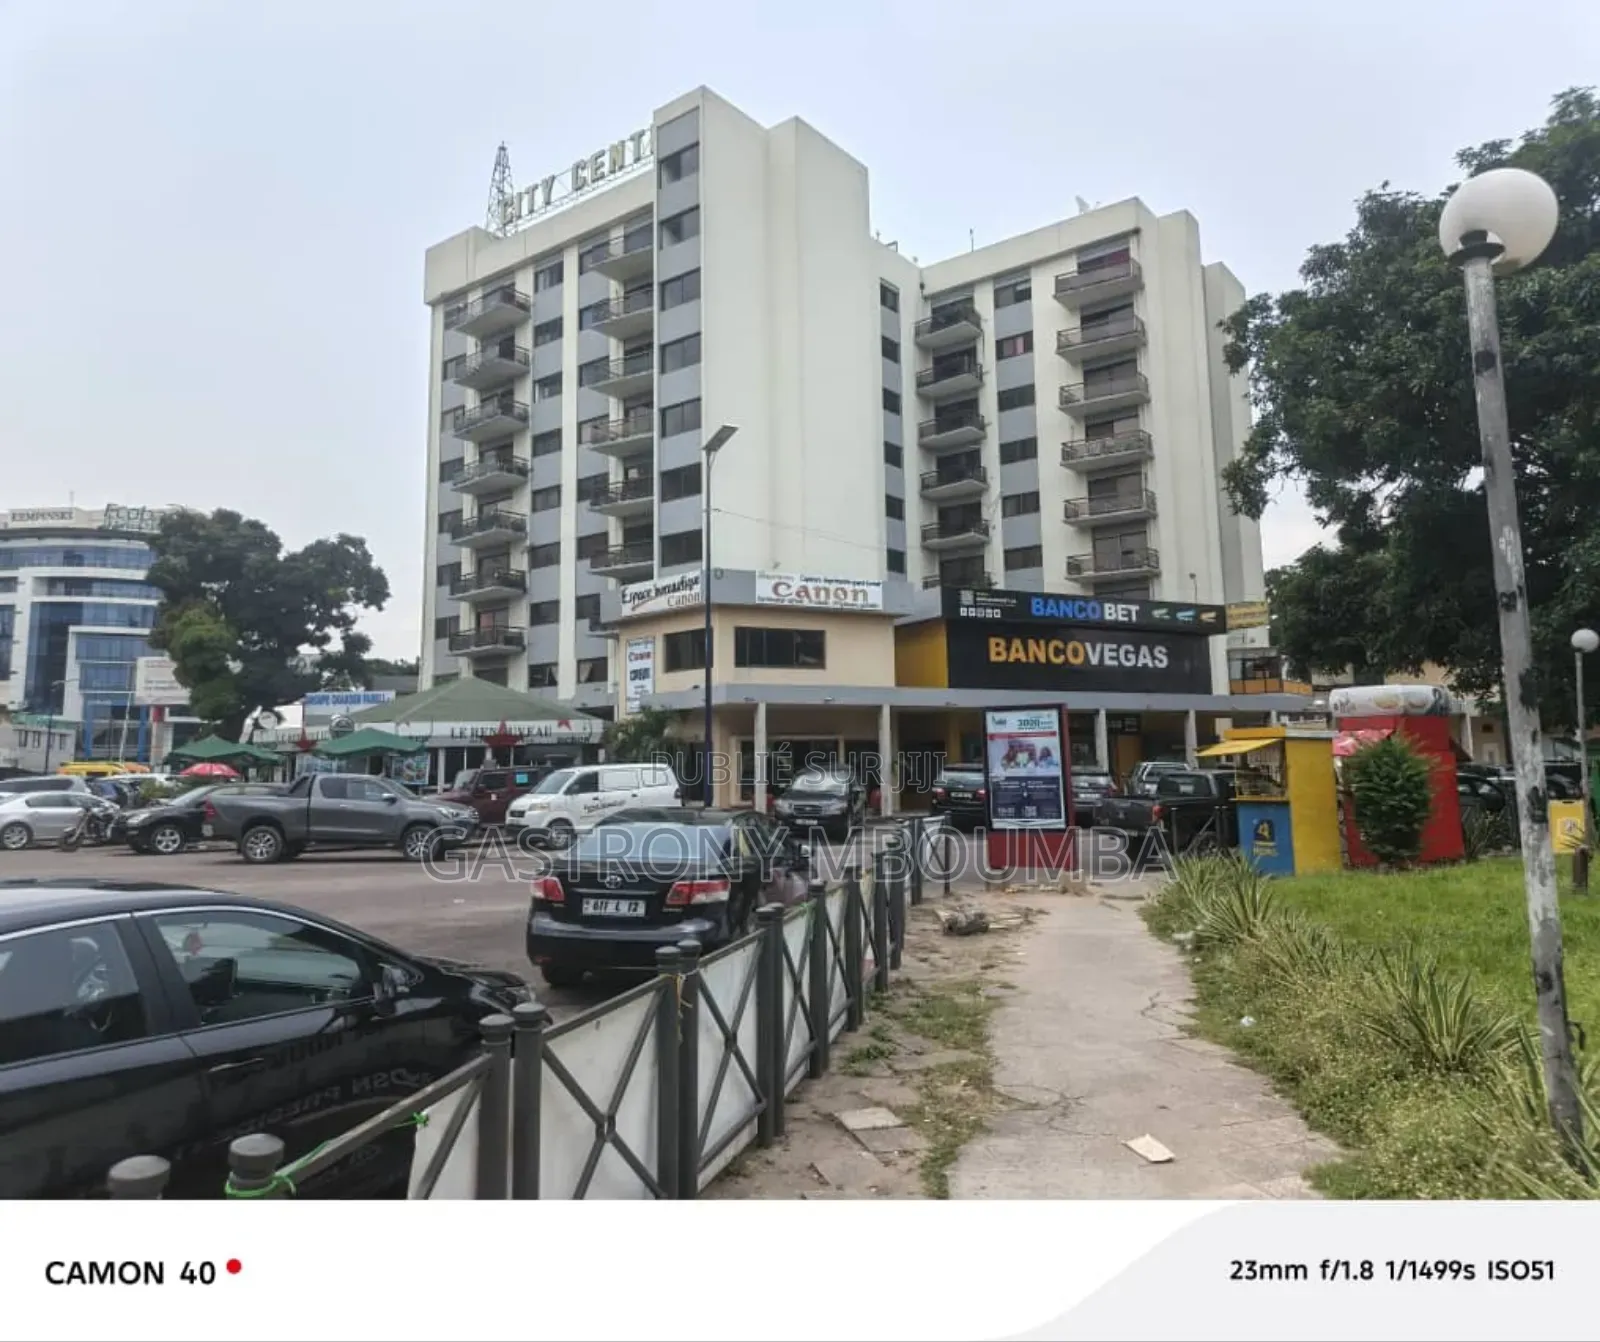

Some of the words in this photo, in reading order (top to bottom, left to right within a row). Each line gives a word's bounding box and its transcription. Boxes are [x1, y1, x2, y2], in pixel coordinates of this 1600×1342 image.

[500, 174, 556, 225] CITY
[667, 591, 700, 607] Canon
[772, 581, 869, 604] Canon
[987, 636, 1170, 669] BANCOVEGAS
[470, 724, 552, 739] RENUVEAU
